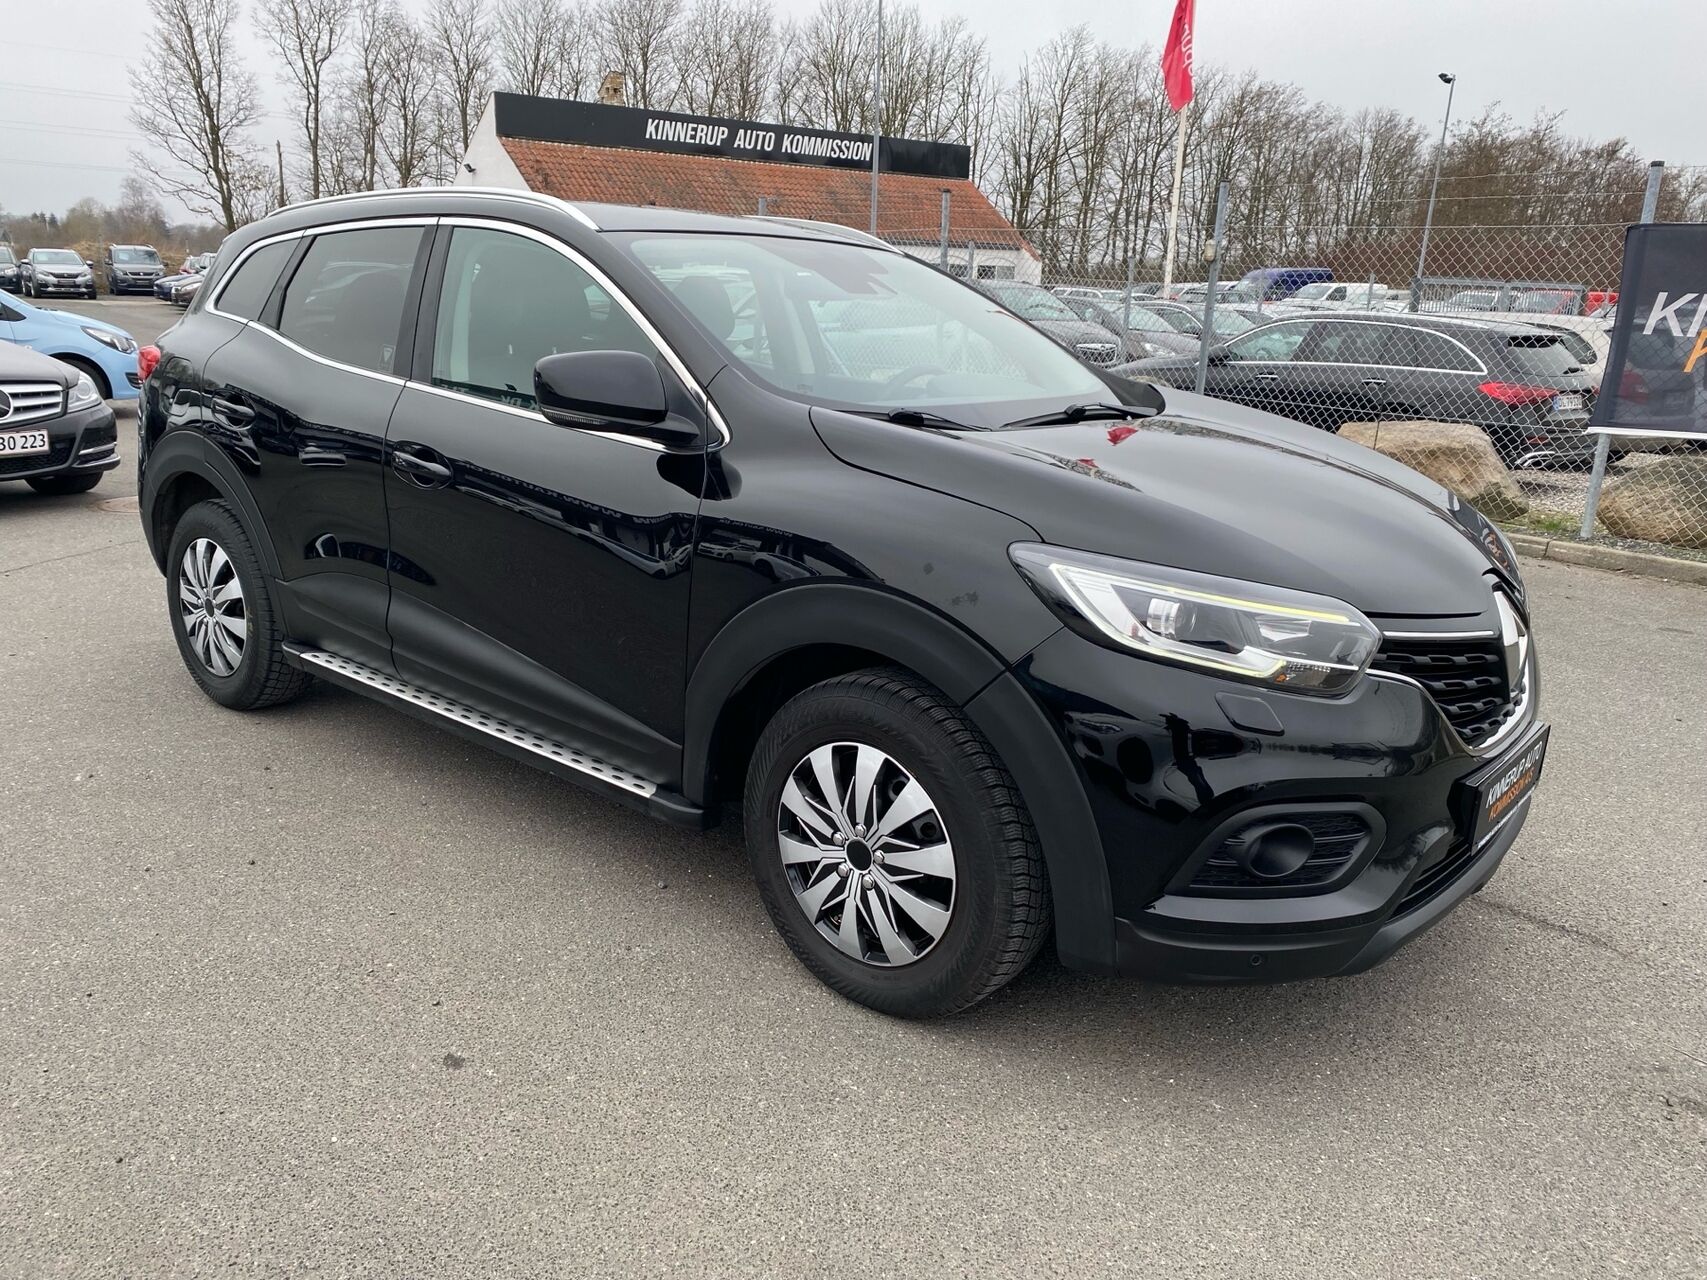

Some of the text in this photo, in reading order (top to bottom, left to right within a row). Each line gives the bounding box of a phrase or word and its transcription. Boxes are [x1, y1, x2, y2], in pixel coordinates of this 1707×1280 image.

[645, 118, 873, 162] KINNERUP AUTO KOMMISSION
[20, 433, 46, 450] 223
[1523, 741, 1543, 769] AUTO
